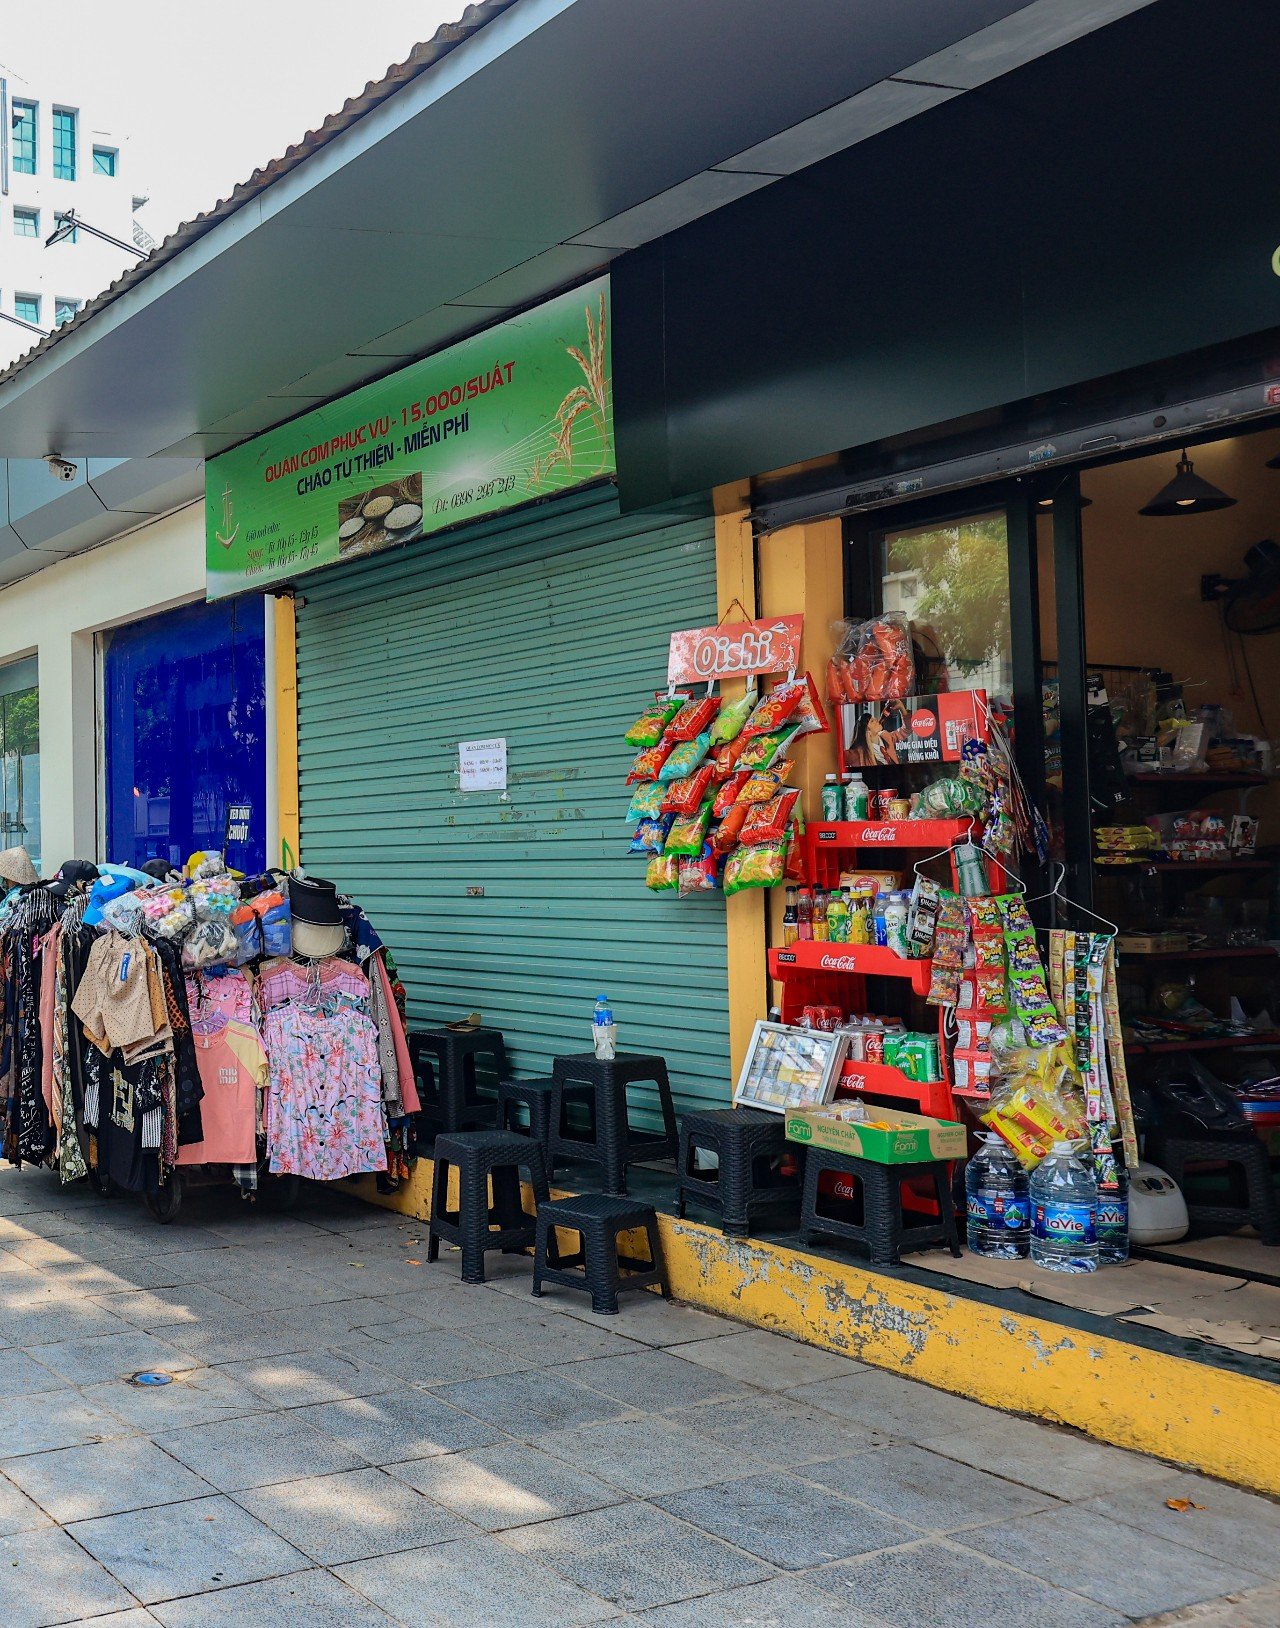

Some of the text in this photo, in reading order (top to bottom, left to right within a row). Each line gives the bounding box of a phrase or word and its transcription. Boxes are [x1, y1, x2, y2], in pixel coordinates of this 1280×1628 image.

[265, 453, 299, 483] QUÁN
[331, 426, 367, 451] PHỤC
[370, 416, 389, 440] VỤ
[297, 466, 332, 495] CHÁO
[354, 443, 394, 473] THIỆN
[404, 422, 441, 454] MIỄN
[443, 408, 469, 439] PHÍ
[693, 631, 773, 676] Oishi
[228, 822, 248, 843] CHUỘT
[967, 1203, 986, 1214] aVie
[1097, 1211, 1125, 1223] aVie
